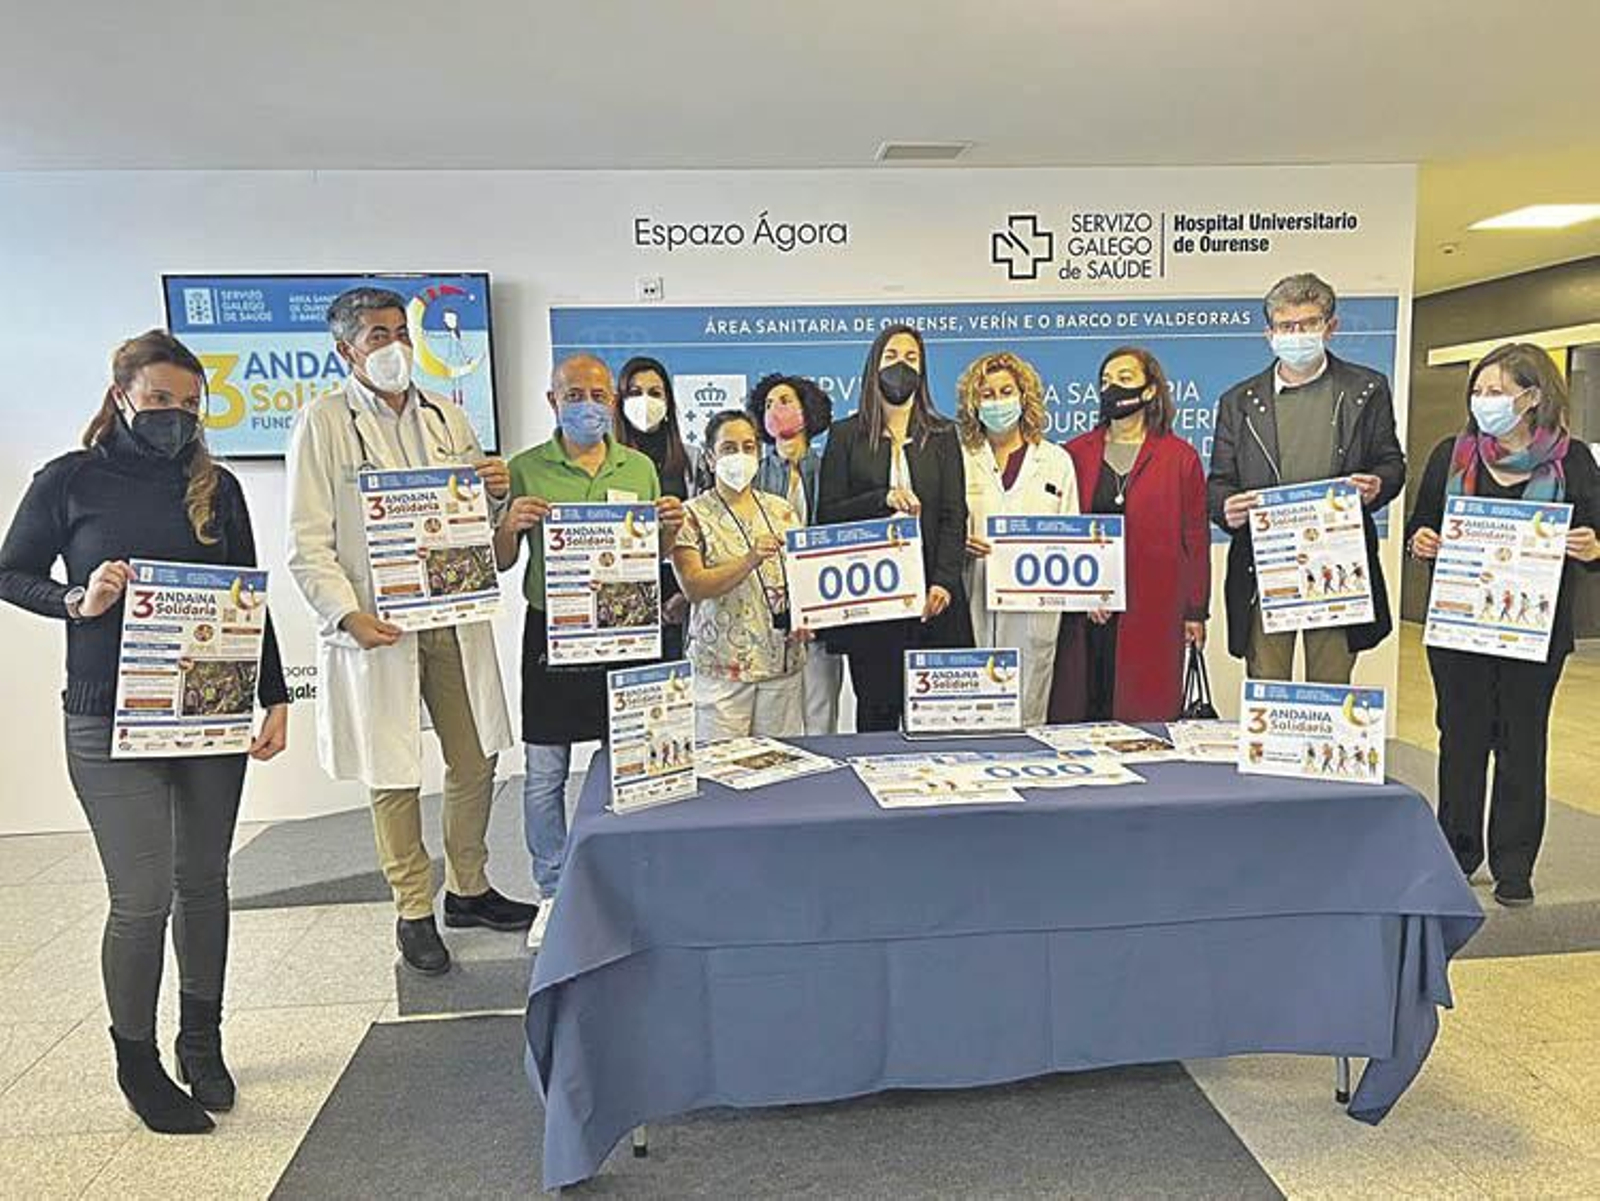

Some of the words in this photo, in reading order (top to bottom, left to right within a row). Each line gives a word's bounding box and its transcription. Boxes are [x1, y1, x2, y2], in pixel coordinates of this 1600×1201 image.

[634, 218, 745, 252] Espazo
[752, 210, 848, 252] Ágora
[1071, 213, 1152, 233] SERVIZO
[1173, 213, 1244, 235] Hospital
[1249, 212, 1358, 231] Universitario
[1067, 237, 1152, 257] GALEGO
[1173, 236, 1195, 253] de
[1199, 235, 1270, 253] Ourense
[1058, 260, 1082, 280] de
[1086, 256, 1152, 280] SAÚDE
[705, 316, 751, 335] ÁREA
[756, 318, 848, 334] SANITARIA
[853, 317, 875, 332] DE
[969, 311, 1018, 330] VERÍN
[1024, 314, 1033, 328] E
[1038, 314, 1051, 328] O
[1056, 313, 1111, 329] BARCO
[1117, 312, 1138, 328] DE
[1143, 311, 1251, 328] VALDEORRAS
[200, 353, 246, 430] 3
[244, 351, 348, 379] ANDA
[367, 496, 386, 521] 3
[1254, 511, 1271, 532] 3
[1445, 518, 1464, 540] 3
[548, 527, 565, 551] 3
[818, 557, 900, 601] 000
[1015, 553, 1099, 587] 000
[132, 590, 155, 619] 3
[916, 671, 931, 694] 3
[613, 690, 627, 713] 3
[1247, 707, 1268, 734] 3
[984, 763, 1094, 779] 000
